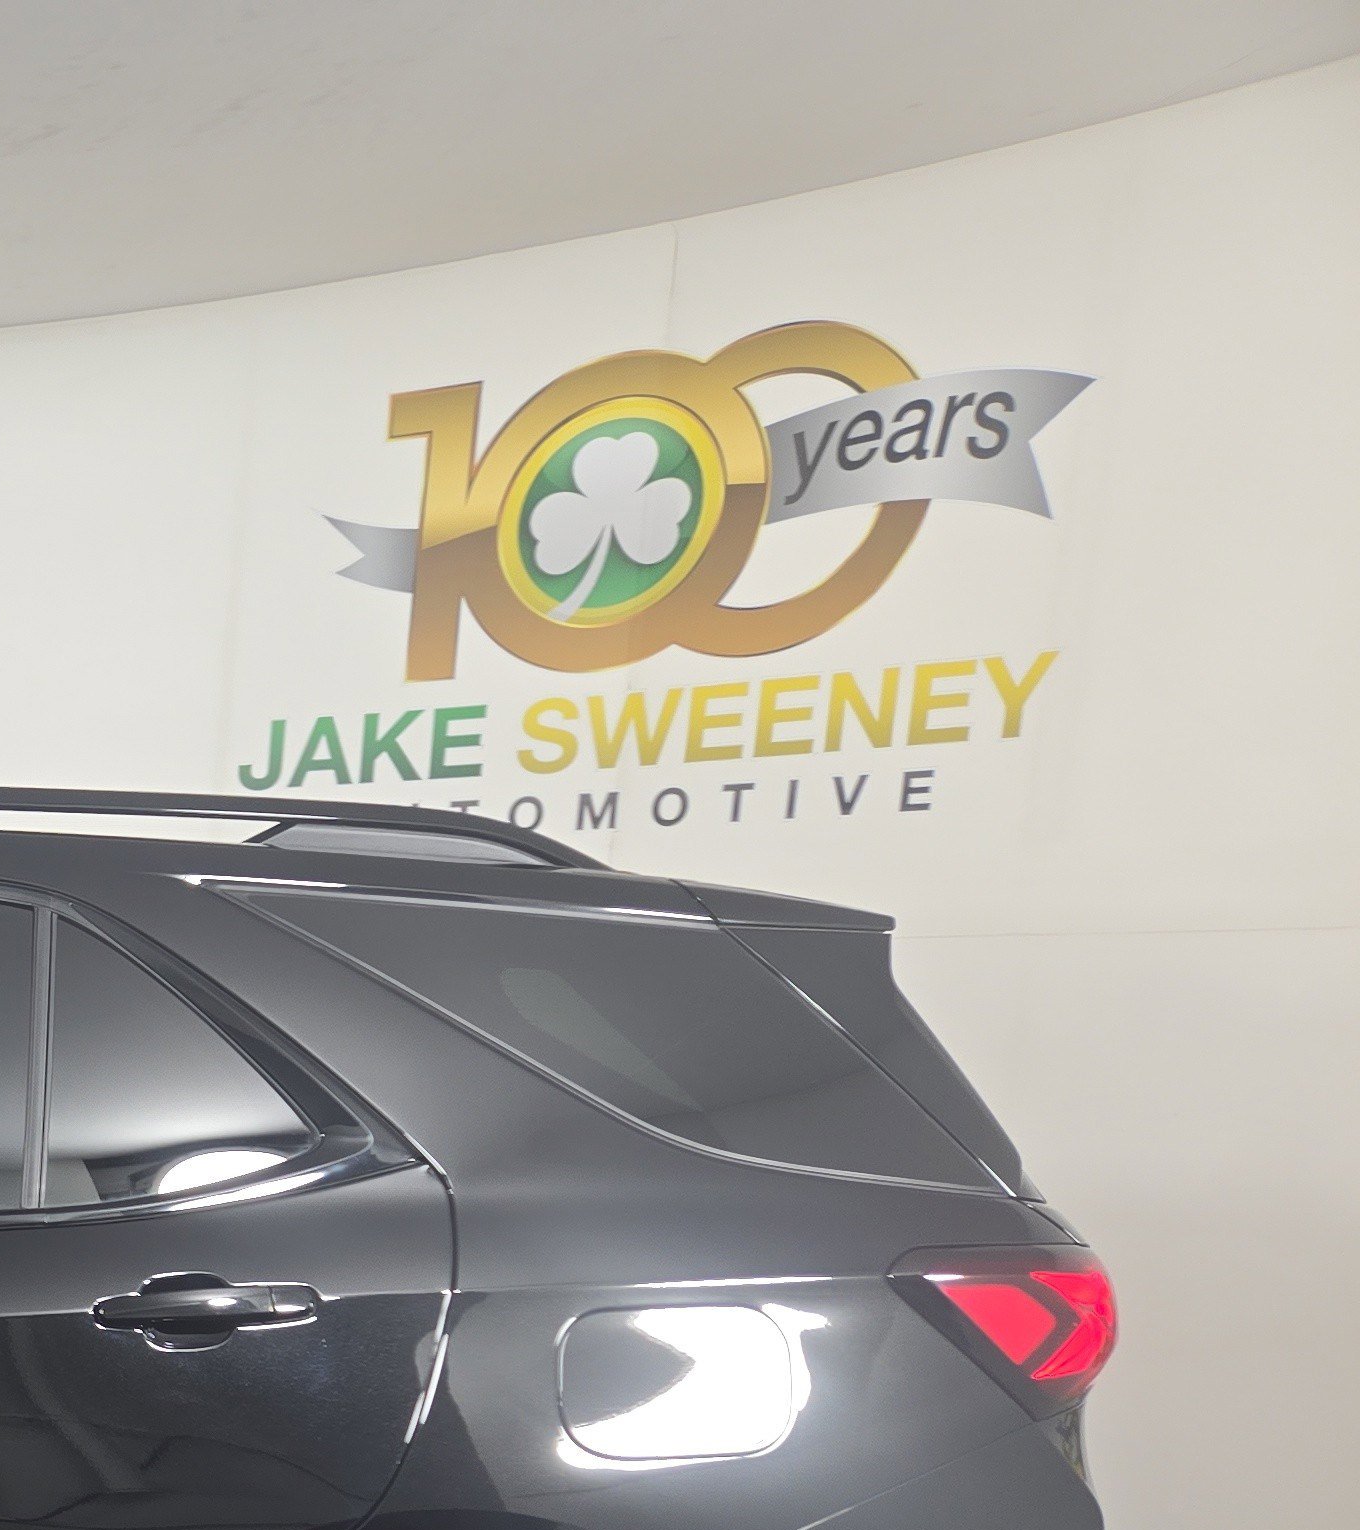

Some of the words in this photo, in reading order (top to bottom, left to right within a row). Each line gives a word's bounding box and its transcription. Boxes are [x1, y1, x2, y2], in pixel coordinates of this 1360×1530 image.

[388, 319, 933, 684] 100
[784, 391, 1015, 506] years
[237, 704, 489, 791] JAKE
[516, 650, 1059, 775] SWEENEY
[449, 769, 936, 831] OMOTIVE
